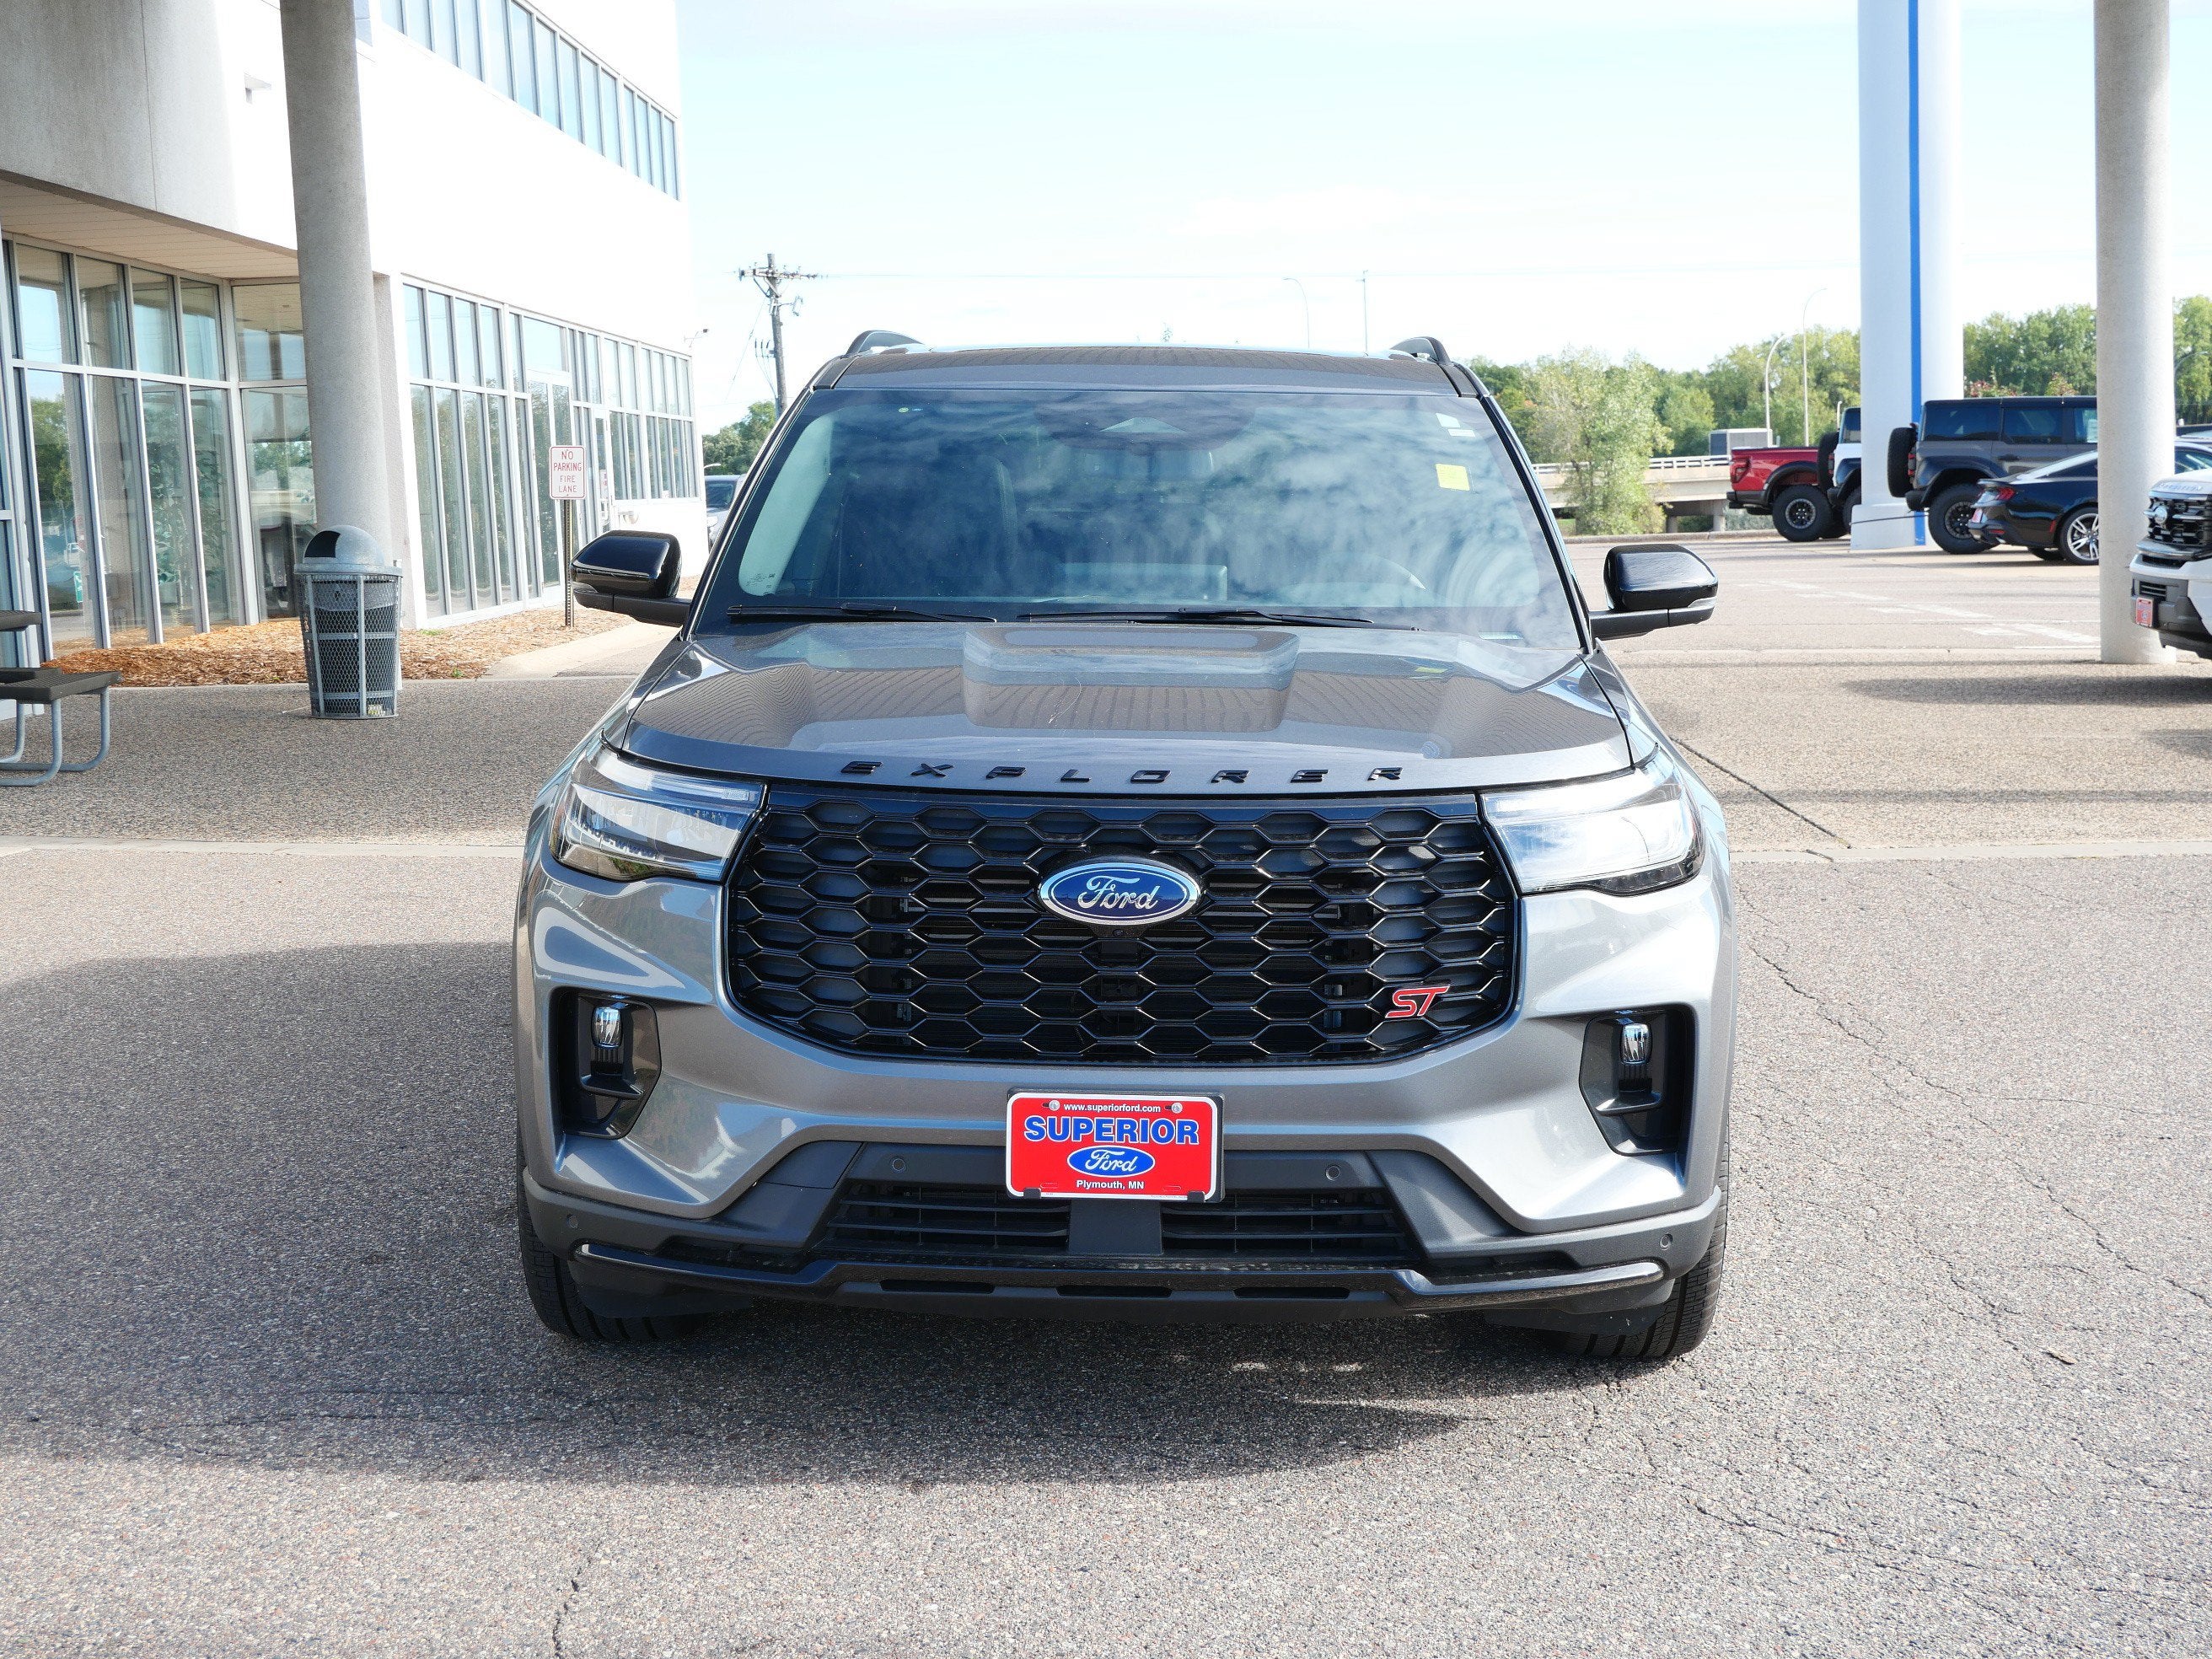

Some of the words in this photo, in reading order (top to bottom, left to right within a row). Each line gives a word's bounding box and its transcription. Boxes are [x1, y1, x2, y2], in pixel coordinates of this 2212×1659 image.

[561, 450, 574, 460] NO
[553, 462, 583, 472] PARKING
[560, 475, 576, 483] FIRE
[558, 485, 577, 493] LANE
[840, 760, 1404, 784] EXPLORER
[1077, 875, 1162, 910] Ford
[1385, 985, 1451, 1018] ST
[1063, 1103, 1161, 1113] www.superiorford.com
[1023, 1115, 1200, 1145] SUPERIOR
[1085, 1149, 1138, 1173] Ford
[1076, 1180, 1125, 1190] Plymouth,
[1128, 1181, 1145, 1189] MN
